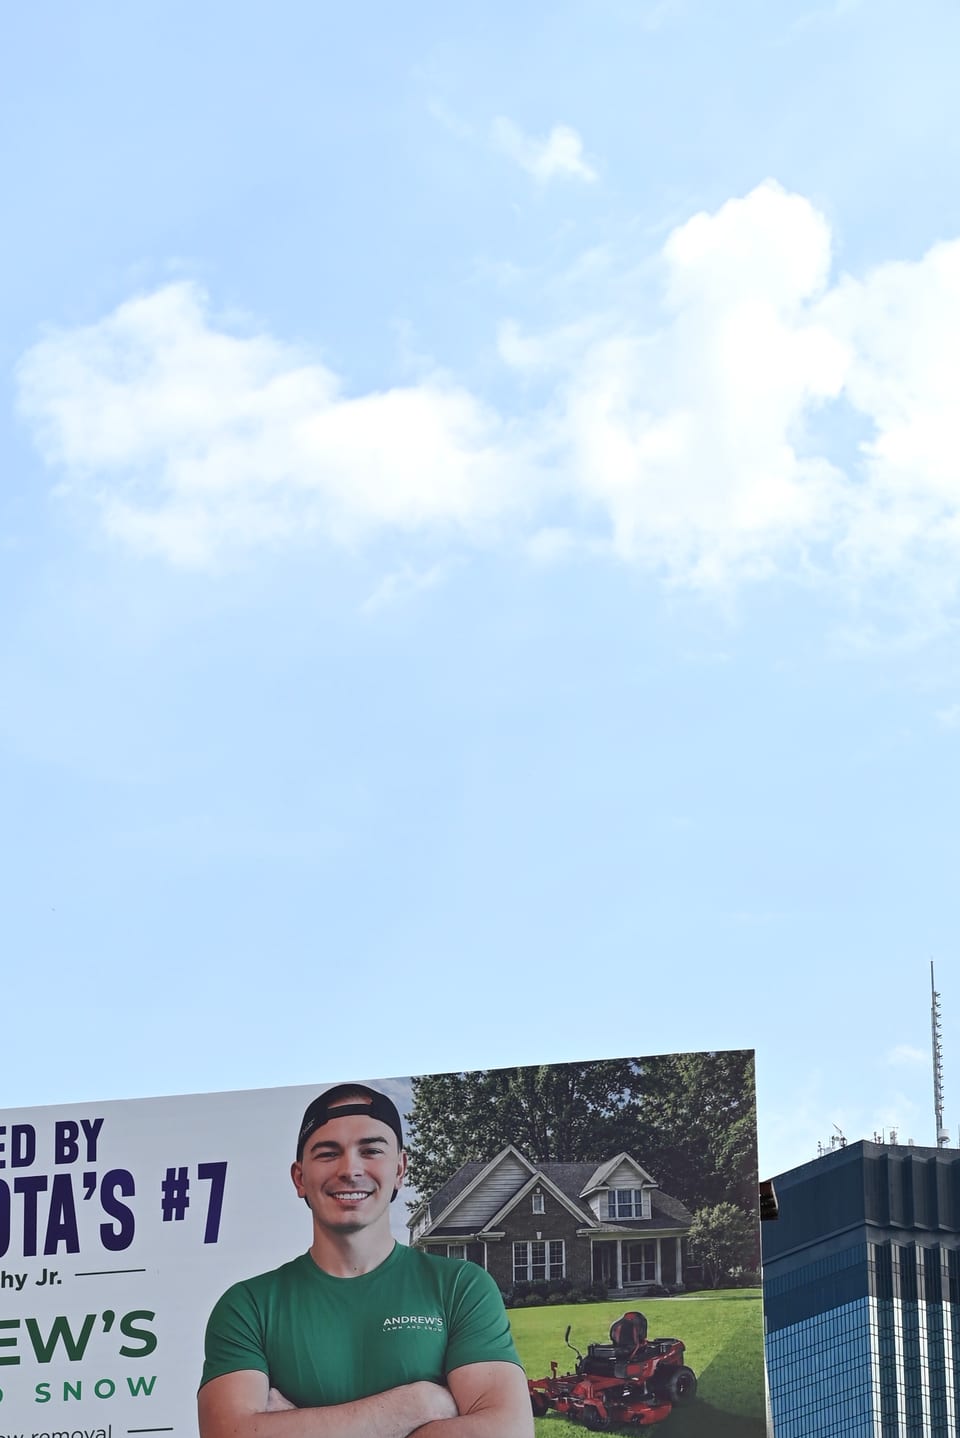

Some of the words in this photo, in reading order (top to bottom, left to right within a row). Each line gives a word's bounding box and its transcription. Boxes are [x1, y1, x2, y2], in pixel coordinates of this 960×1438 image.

[54, 1118, 105, 1165] BY
[161, 1161, 228, 1245] #7
[34, 1268, 62, 1288] Jr.
[383, 1316, 443, 1326] ANDREW'S
[34, 1375, 158, 1404] SNOW
